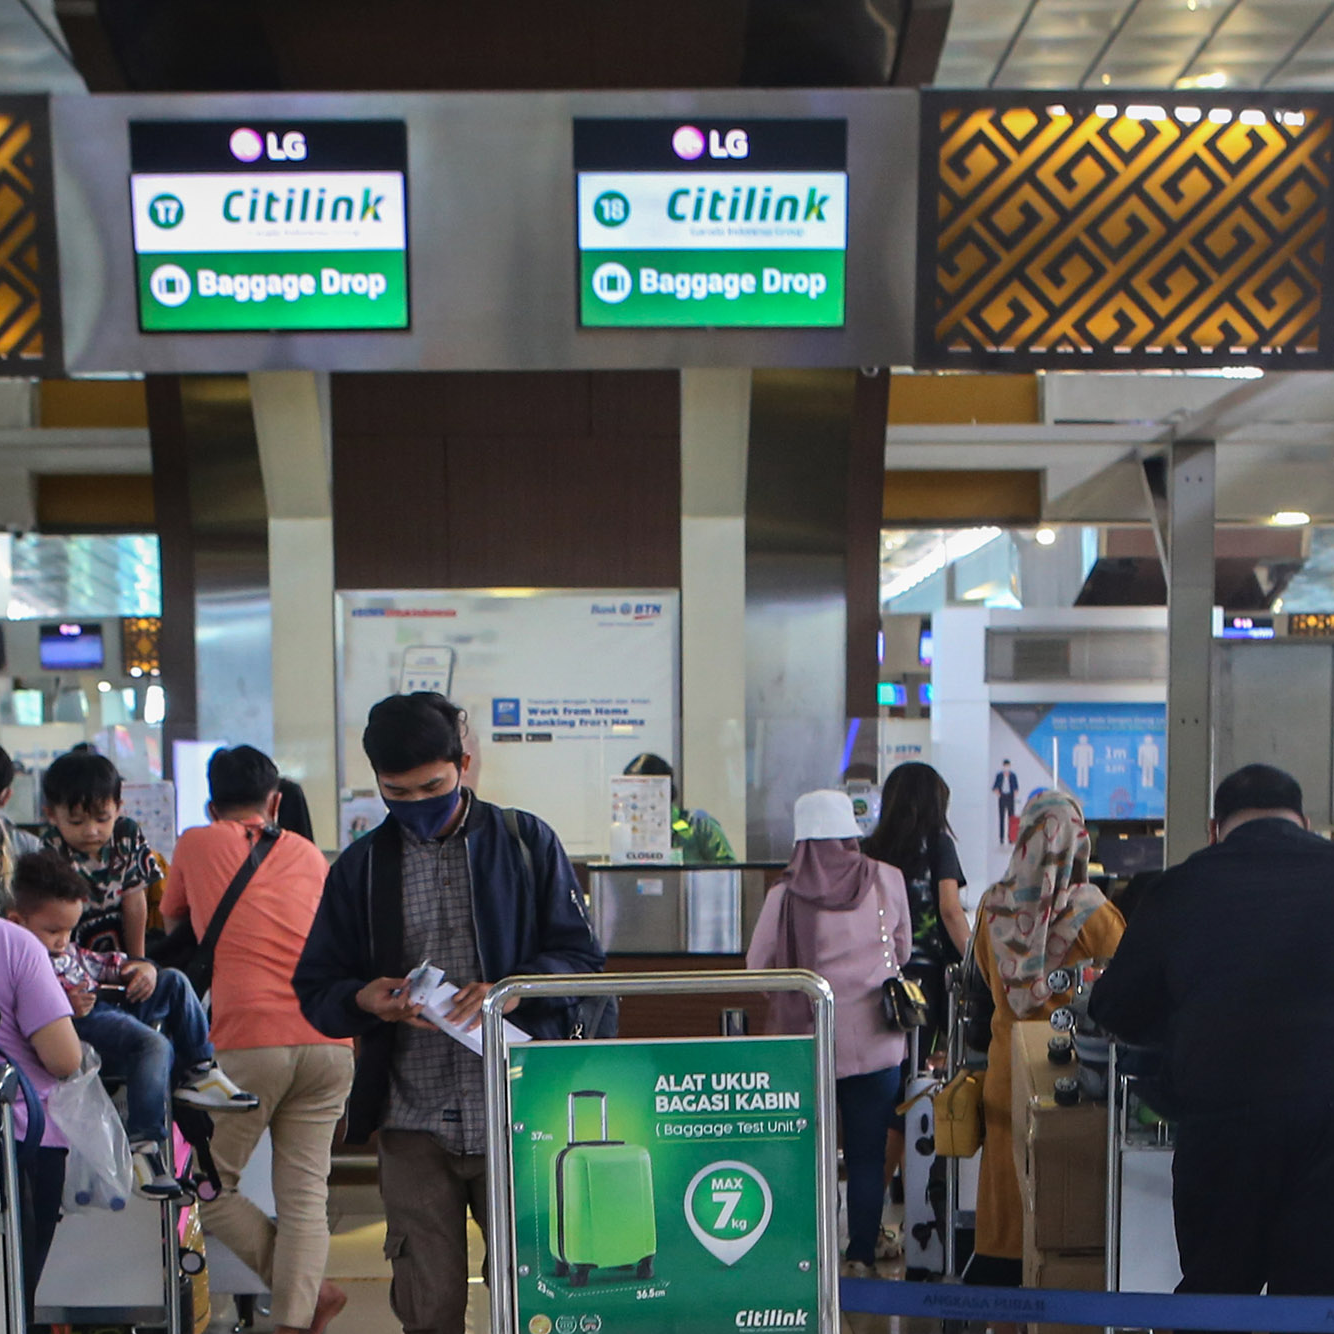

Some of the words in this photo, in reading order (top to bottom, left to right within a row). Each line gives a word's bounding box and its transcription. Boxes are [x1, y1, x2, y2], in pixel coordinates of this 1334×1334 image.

[266, 131, 307, 161] LG
[709, 129, 750, 159] LG
[153, 202, 180, 223] 17
[223, 188, 384, 222] Citilink
[600, 197, 624, 220] 18
[667, 187, 830, 221] Citilink
[197, 268, 316, 302] Baggage
[321, 267, 387, 300] Drop
[640, 267, 756, 301] Baggage
[762, 267, 827, 299] Drop
[591, 603, 617, 615] Bank
[634, 603, 662, 615] BTN
[527, 707, 558, 716] Work
[563, 706, 591, 716] from
[594, 707, 629, 716] Home
[527, 718, 576, 729] Banking
[626, 852, 663, 860] CLOSED
[654, 1074, 706, 1093] ALAT
[711, 1072, 770, 1091] UKUR
[654, 1094, 730, 1113] BAGASI
[735, 1092, 800, 1111] KABIN
[531, 1132, 553, 1141] 37cm
[664, 1123, 733, 1137] Baggage
[737, 1122, 764, 1133] Test
[768, 1121, 794, 1132] Unit
[711, 1178, 743, 1190] MAX
[636, 1287, 666, 1300] 36.5cm
[735, 1308, 809, 1327] Citilink
